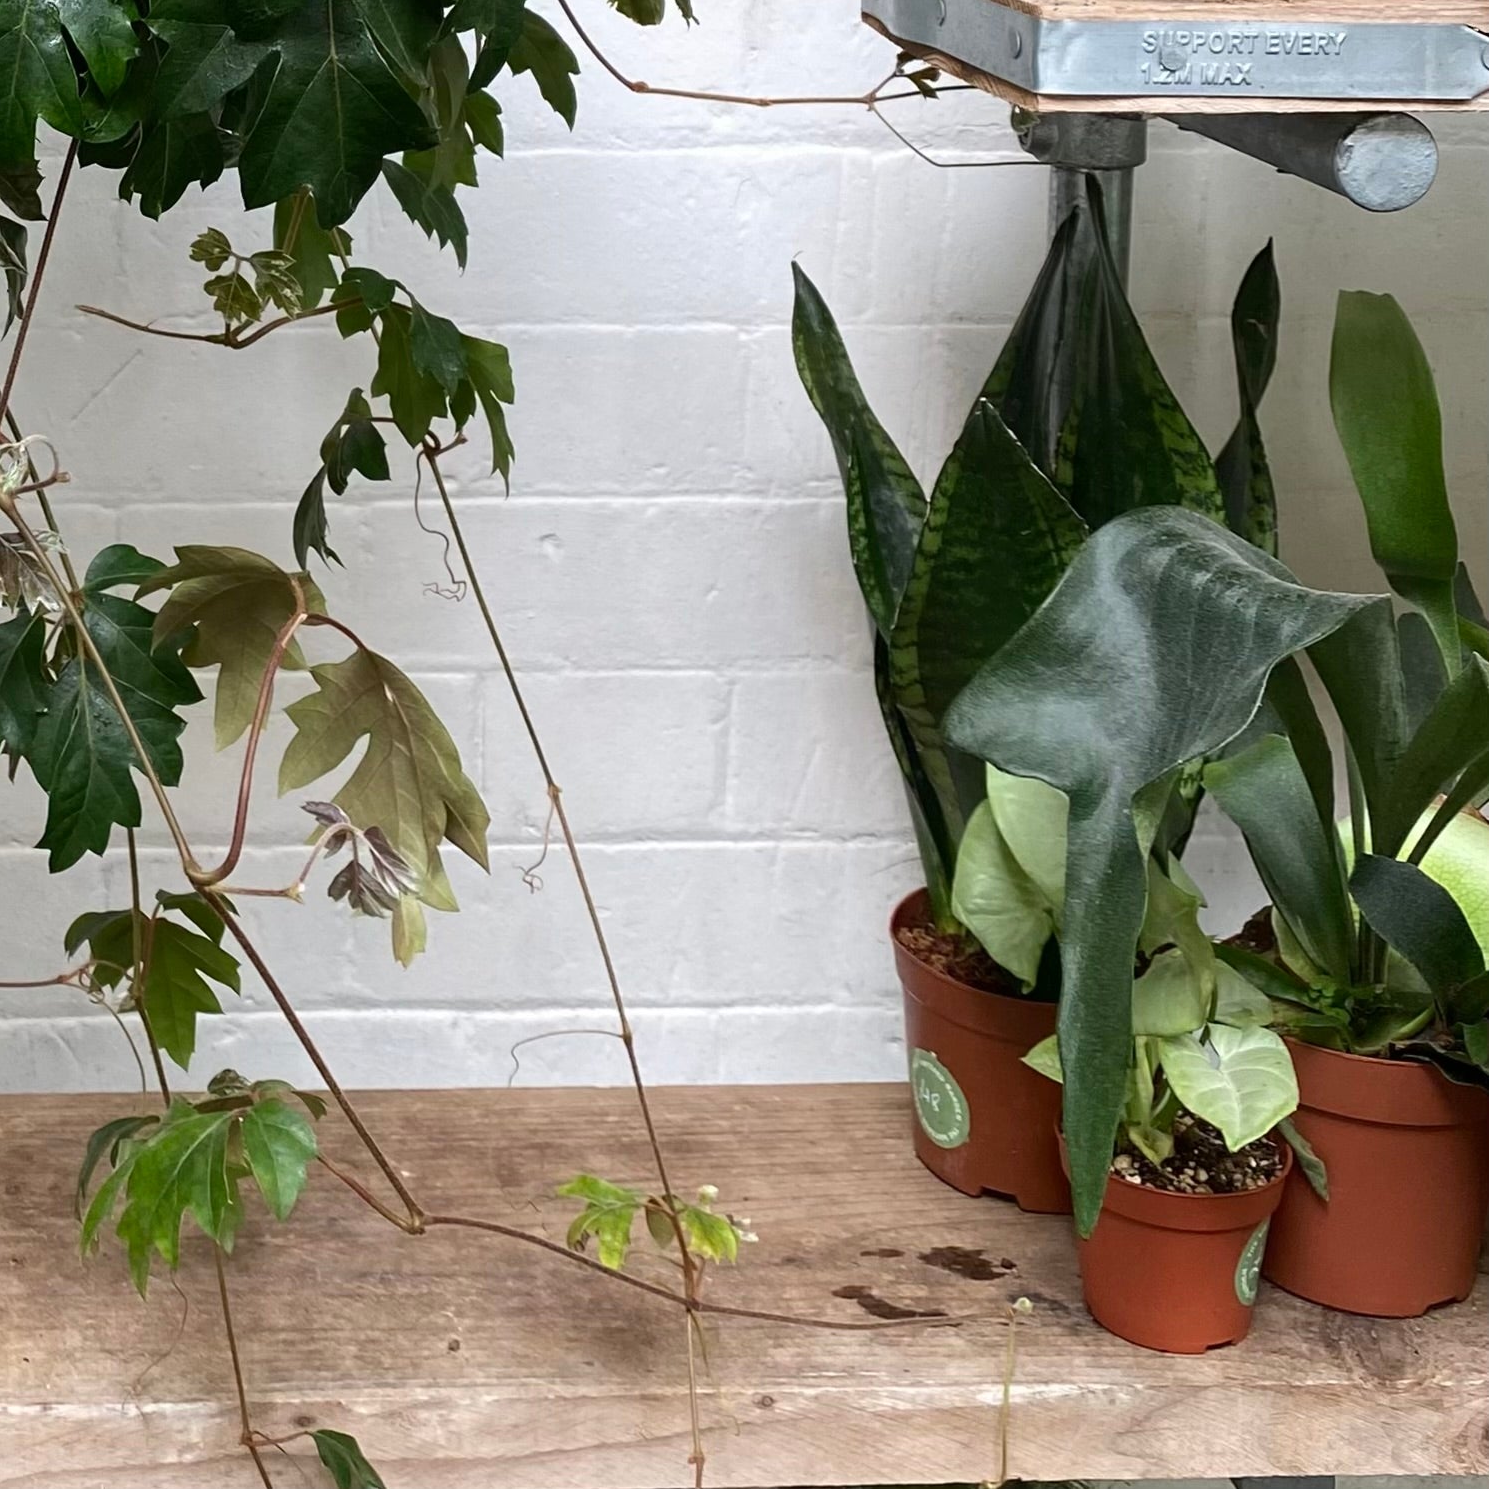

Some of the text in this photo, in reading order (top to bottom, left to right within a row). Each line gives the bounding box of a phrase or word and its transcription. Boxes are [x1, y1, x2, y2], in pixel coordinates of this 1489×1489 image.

[1141, 30, 1347, 55] SUPPORT EVERY
[1200, 62, 1253, 86] MAX
